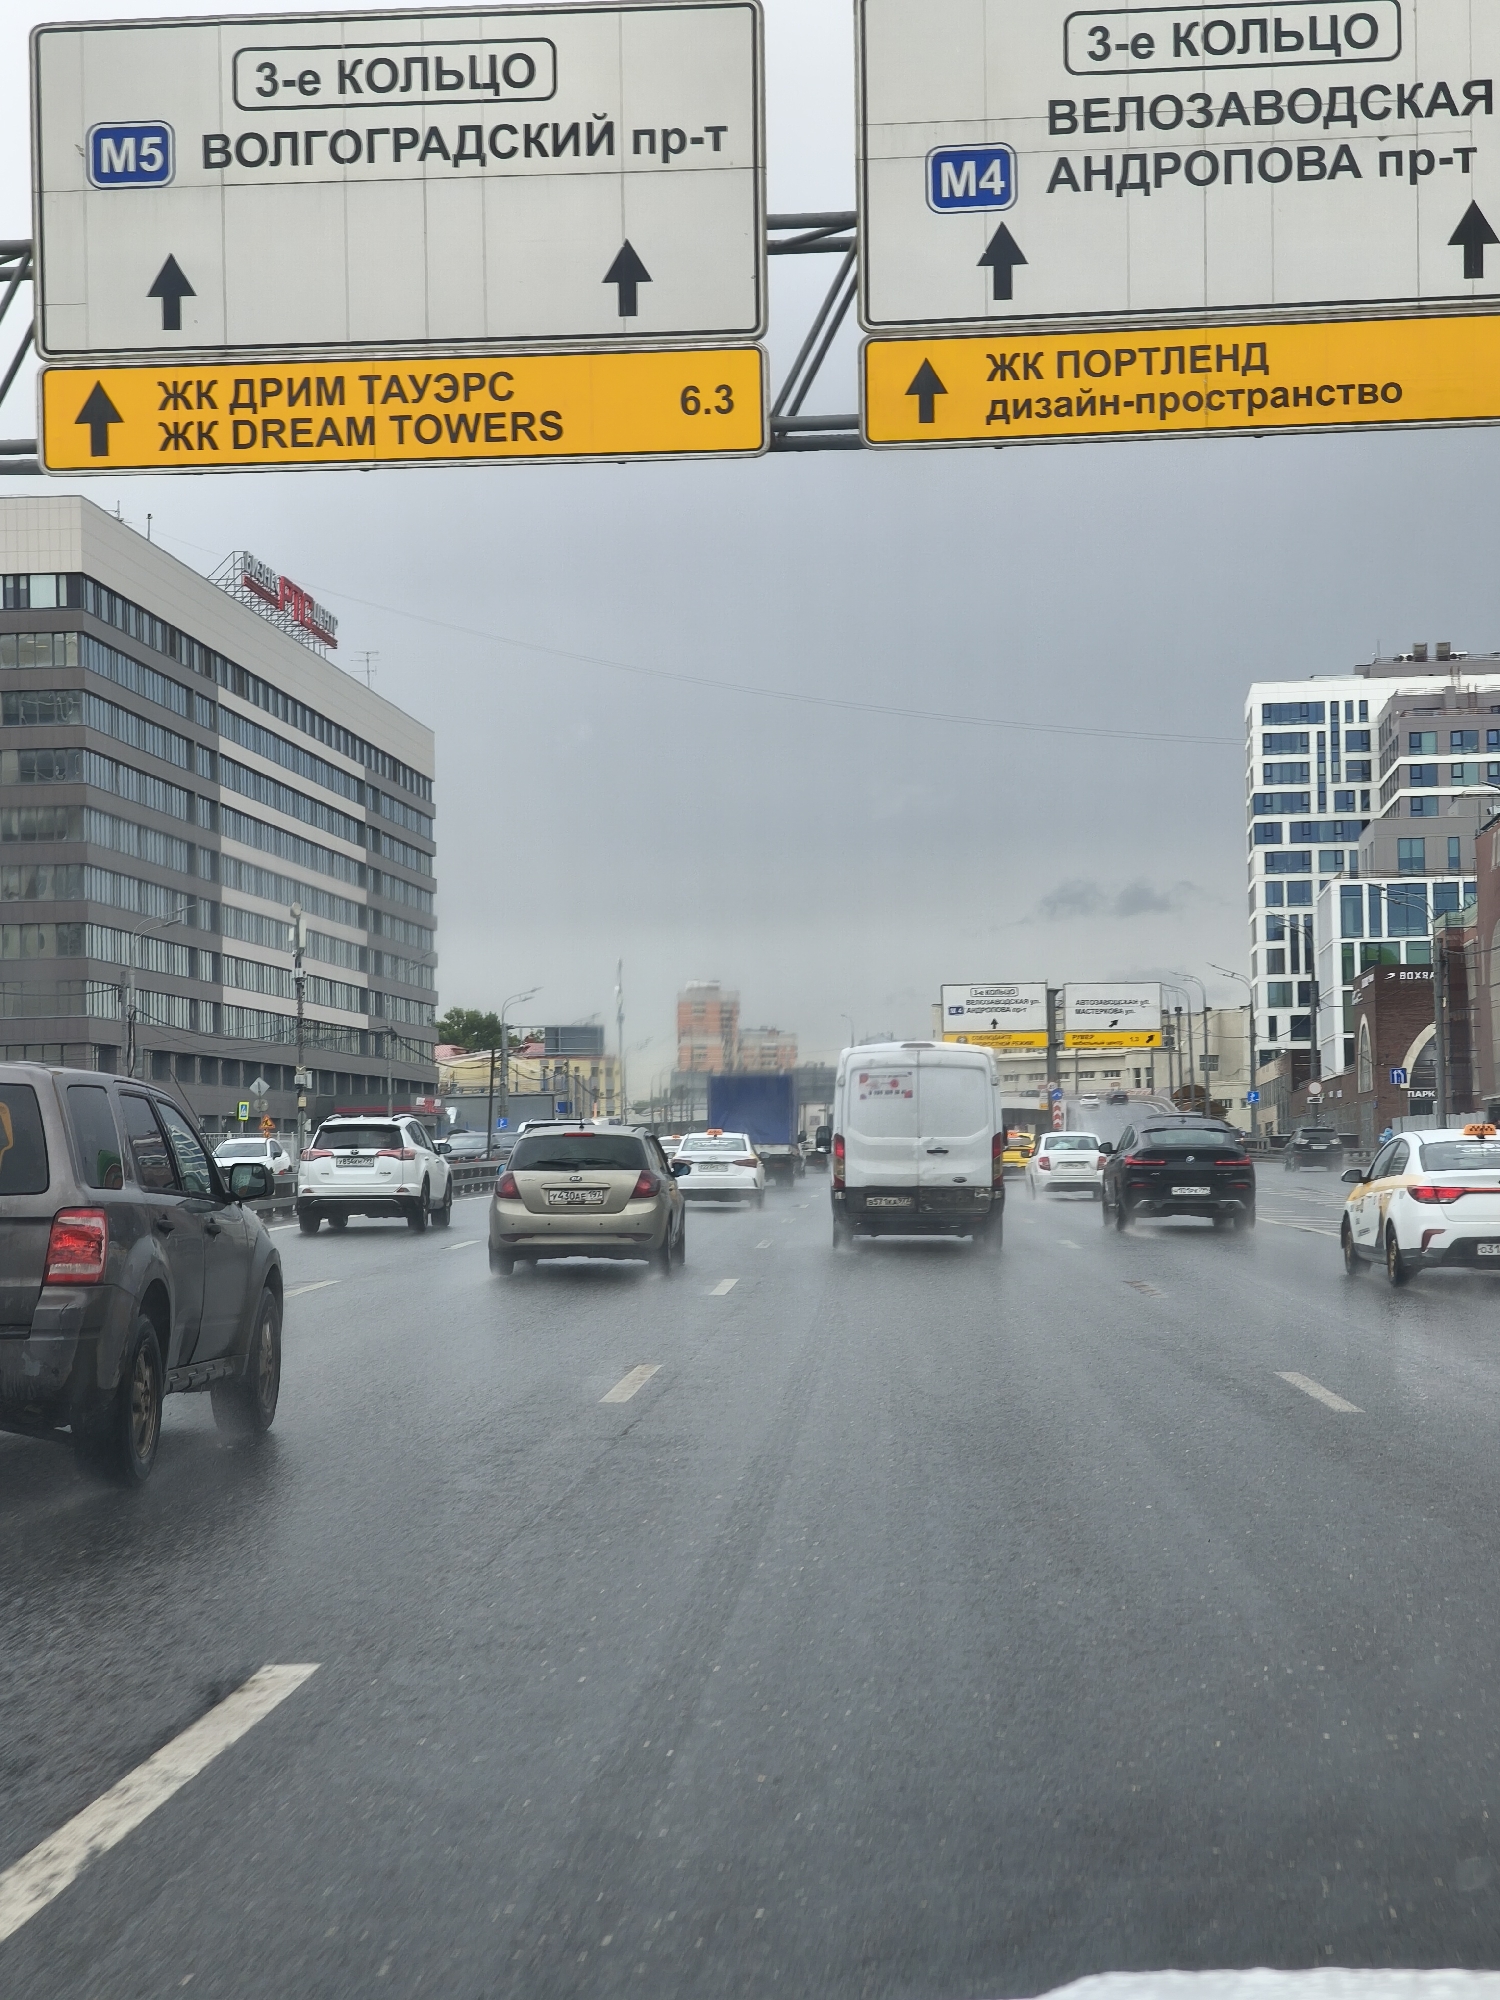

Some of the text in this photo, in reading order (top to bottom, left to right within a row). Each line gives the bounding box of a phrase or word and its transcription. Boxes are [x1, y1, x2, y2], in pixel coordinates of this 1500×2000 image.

[1089, 12, 1379, 61] 3-е КОЛЬЦО
[257, 53, 537, 98] 3-е КОЛЬЦО
[1048, 79, 1494, 136] ВЕЛОЗАВОДСКАЯ
[102, 137, 162, 172] М5
[202, 114, 728, 169] ВОЛГОГРАДСКИЙ пр-т
[942, 159, 1004, 197] М4
[1046, 144, 1477, 196] АНДРОПОВА пр-т
[987, 342, 1269, 381] ЖК ПОРТЛЕНД
[158, 372, 513, 416] ЖК ДРИМ ТАУЭРС
[681, 385, 733, 415] 6.3
[985, 381, 1403, 425] дизайн-пространство
[159, 411, 563, 451] ЖК DREAM TOWERS
[1407, 1090, 1435, 1098] ПАРК
